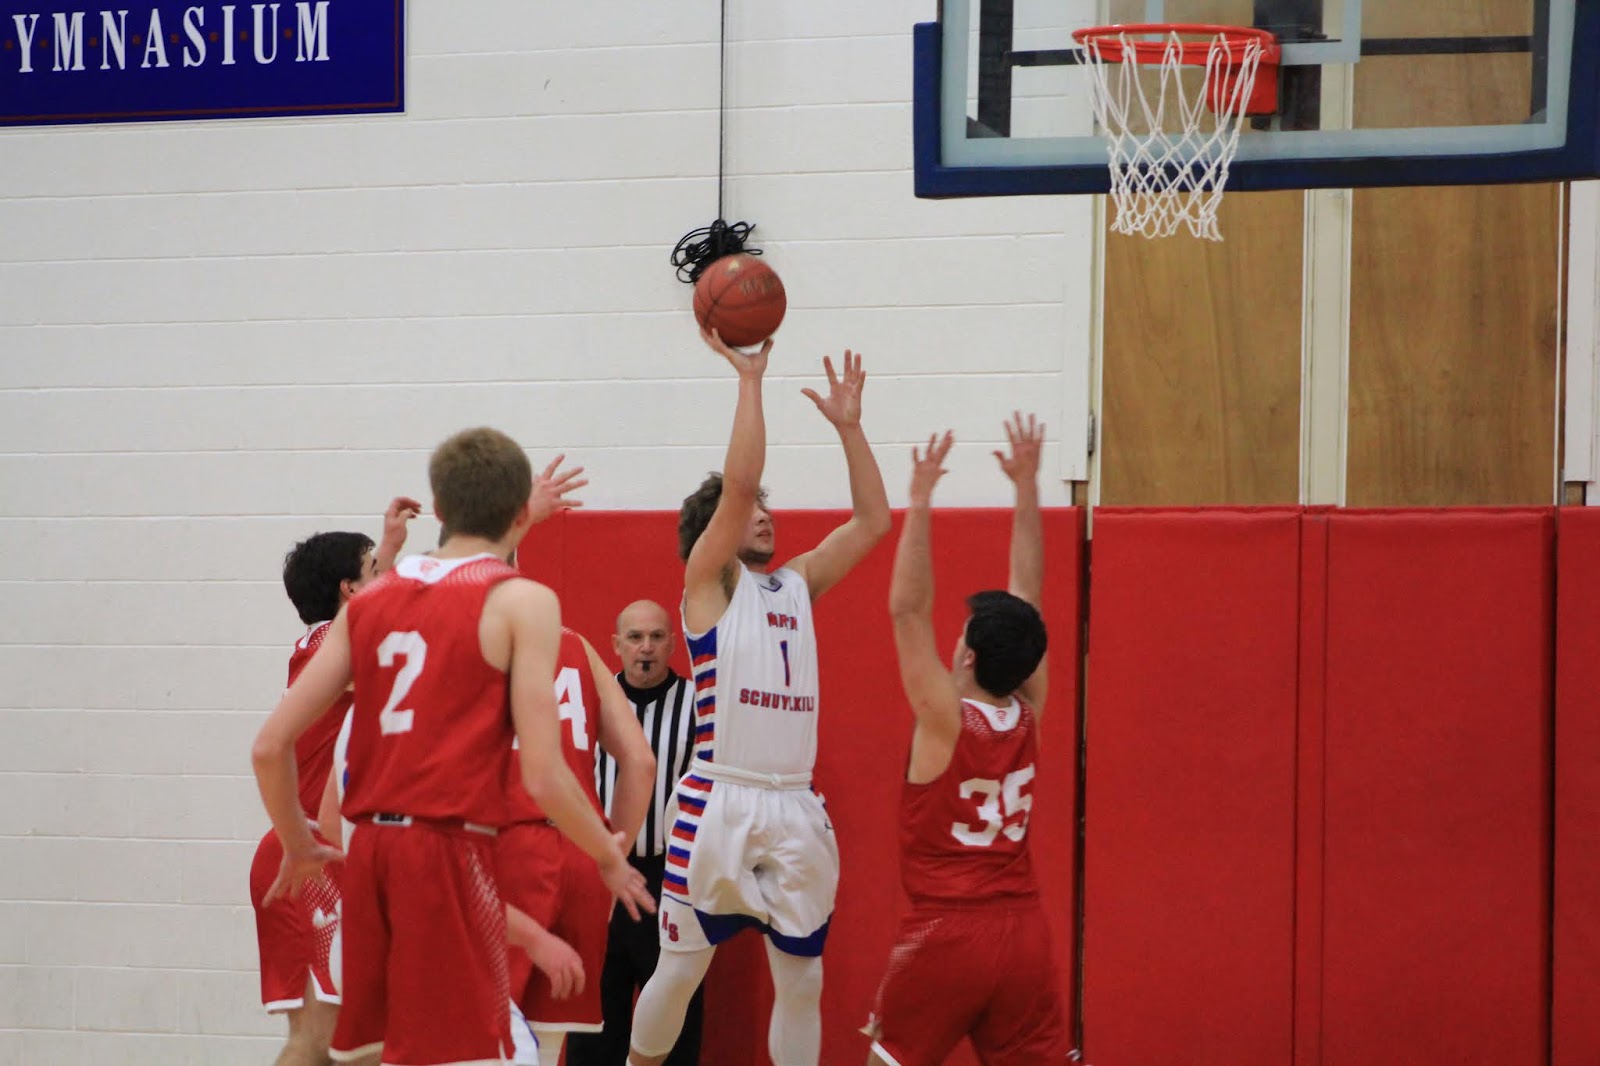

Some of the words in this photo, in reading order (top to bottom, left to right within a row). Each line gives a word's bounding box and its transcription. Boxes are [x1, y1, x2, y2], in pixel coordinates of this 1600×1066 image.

[376, 630, 428, 736] 2
[779, 640, 791, 687] 1
[951, 762, 1036, 847] 35
